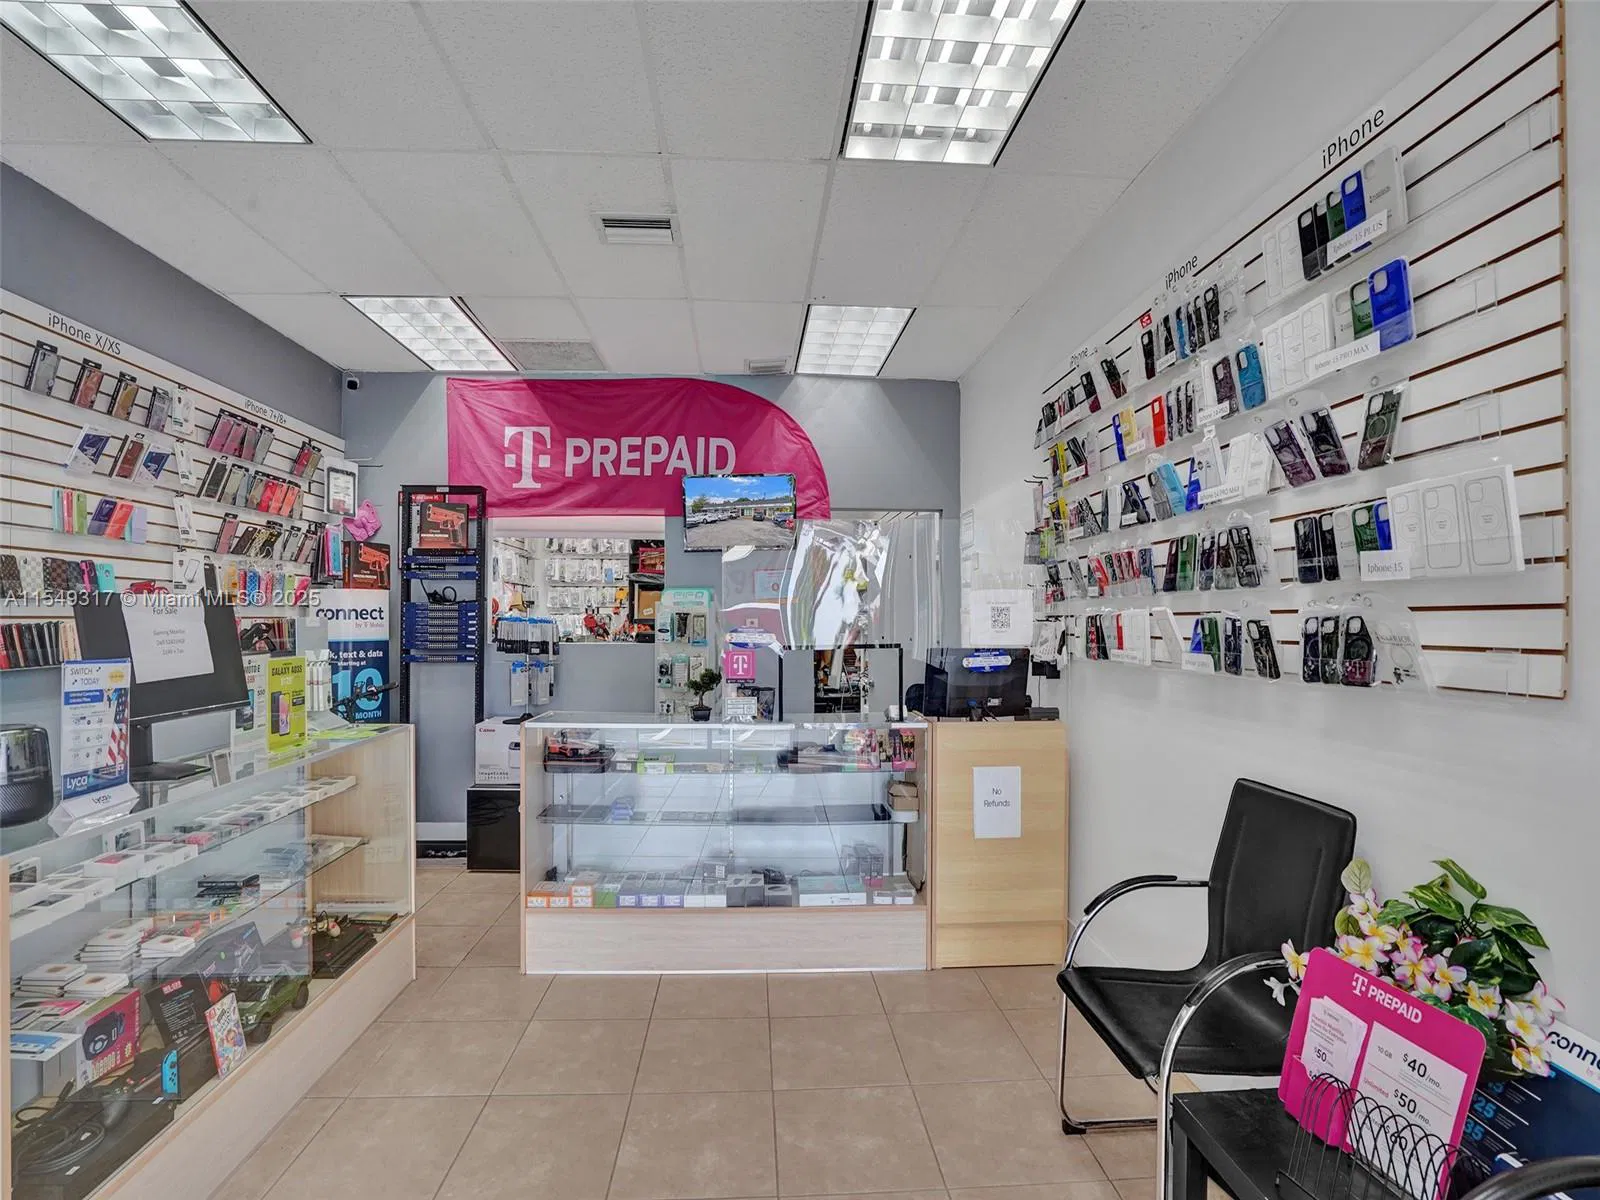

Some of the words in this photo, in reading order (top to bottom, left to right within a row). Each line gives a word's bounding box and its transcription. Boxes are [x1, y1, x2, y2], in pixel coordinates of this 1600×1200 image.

[1322, 109, 1385, 169] iPhone
[1165, 255, 1198, 290] iPhone
[48, 313, 92, 343] iPhone
[95, 333, 121, 356] X/XS
[245, 398, 268, 417] iPhone
[504, 426, 551, 489] T
[565, 435, 737, 478] PREPAID
[152, 607, 164, 615] For
[164, 606, 178, 615] Sale
[316, 606, 385, 621] connect
[339, 650, 358, 659] text
[359, 650, 366, 658] &
[367, 650, 384, 658] data
[70, 666, 93, 676] SWITCH
[271, 667, 290, 677] GALAXY
[355, 710, 383, 720] MONTH
[66, 775, 88, 790] Lyca
[992, 787, 1002, 796] No
[983, 799, 1011, 808] Refunds
[1367, 984, 1423, 1024] PREPAID
[1547, 1031, 1600, 1072] conn
[1473, 1096, 1497, 1119] 25
[1464, 1118, 1485, 1141] 35
